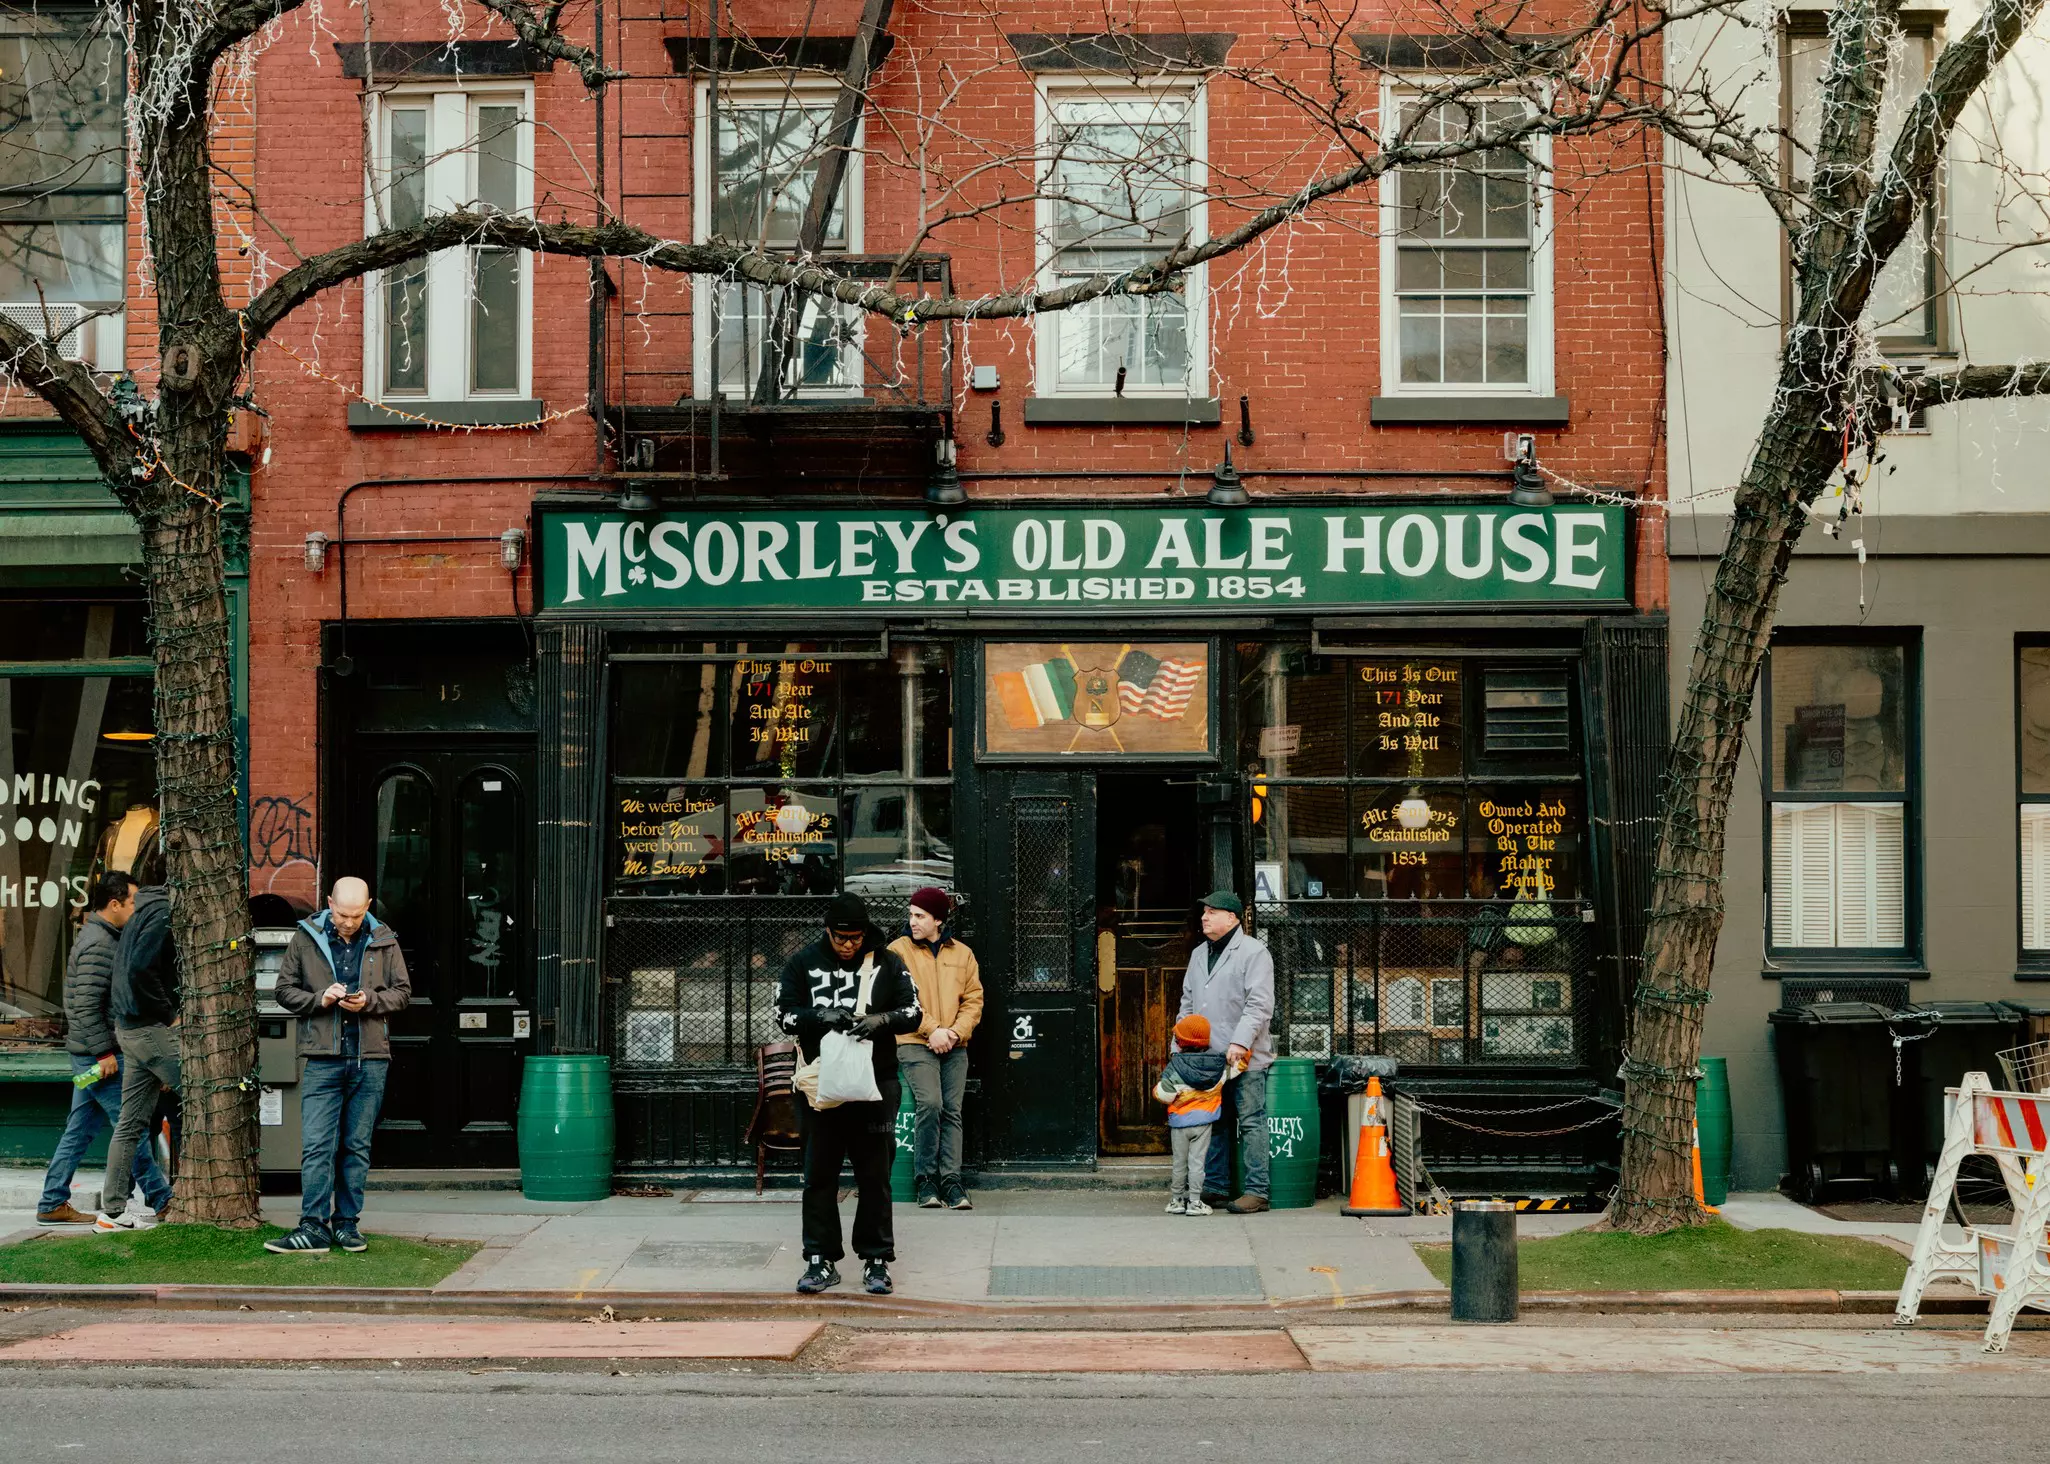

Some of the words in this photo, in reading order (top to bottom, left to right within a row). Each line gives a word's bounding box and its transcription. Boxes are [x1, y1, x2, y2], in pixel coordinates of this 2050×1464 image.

[1012, 519, 1126, 571] OLD
[1144, 518, 1294, 570] ALE
[1323, 512, 1608, 590] HOUSE
[861, 577, 1196, 602] ESTABLISHED
[1206, 576, 1307, 599] 1854
[736, 660, 772, 674] This
[777, 660, 796, 674] Is
[800, 659, 832, 674] Our
[1361, 666, 1397, 682] This
[1403, 664, 1421, 682] Is
[1425, 665, 1458, 682] Our
[441, 684, 461, 701] 15
[747, 683, 772, 697] 171
[778, 682, 813, 699] Year
[1376, 691, 1401, 705] 171
[1405, 690, 1443, 708] Year
[749, 704, 780, 720] And
[784, 704, 812, 720] Ale
[1379, 712, 1410, 728] And
[1414, 712, 1440, 728] Ale
[749, 726, 769, 742] Is
[775, 727, 809, 742] Well
[1379, 736, 1399, 750] Is
[1403, 735, 1439, 751] Well
[621, 799, 645, 813] We
[649, 801, 683, 813] were
[685, 799, 715, 813] here
[1479, 800, 1533, 817] Owned
[1536, 799, 1567, 817] And
[735, 810, 761, 830] Mc
[1361, 807, 1388, 829] Mc
[1488, 818, 1563, 835] Operated
[621, 822, 666, 837] before
[669, 821, 699, 839] You
[743, 829, 823, 845] Established
[1370, 827, 1450, 844] Established
[625, 841, 659, 853] were
[661, 838, 697, 853] born.
[1497, 835, 1519, 853] By
[1527, 835, 1555, 850] The
[763, 847, 799, 862] 1854
[1391, 851, 1428, 865] 1854
[1499, 853, 1553, 872] Maher
[623, 860, 647, 875] Mc
[651, 859, 707, 877] Sorley's
[1500, 872, 1556, 891] Family
